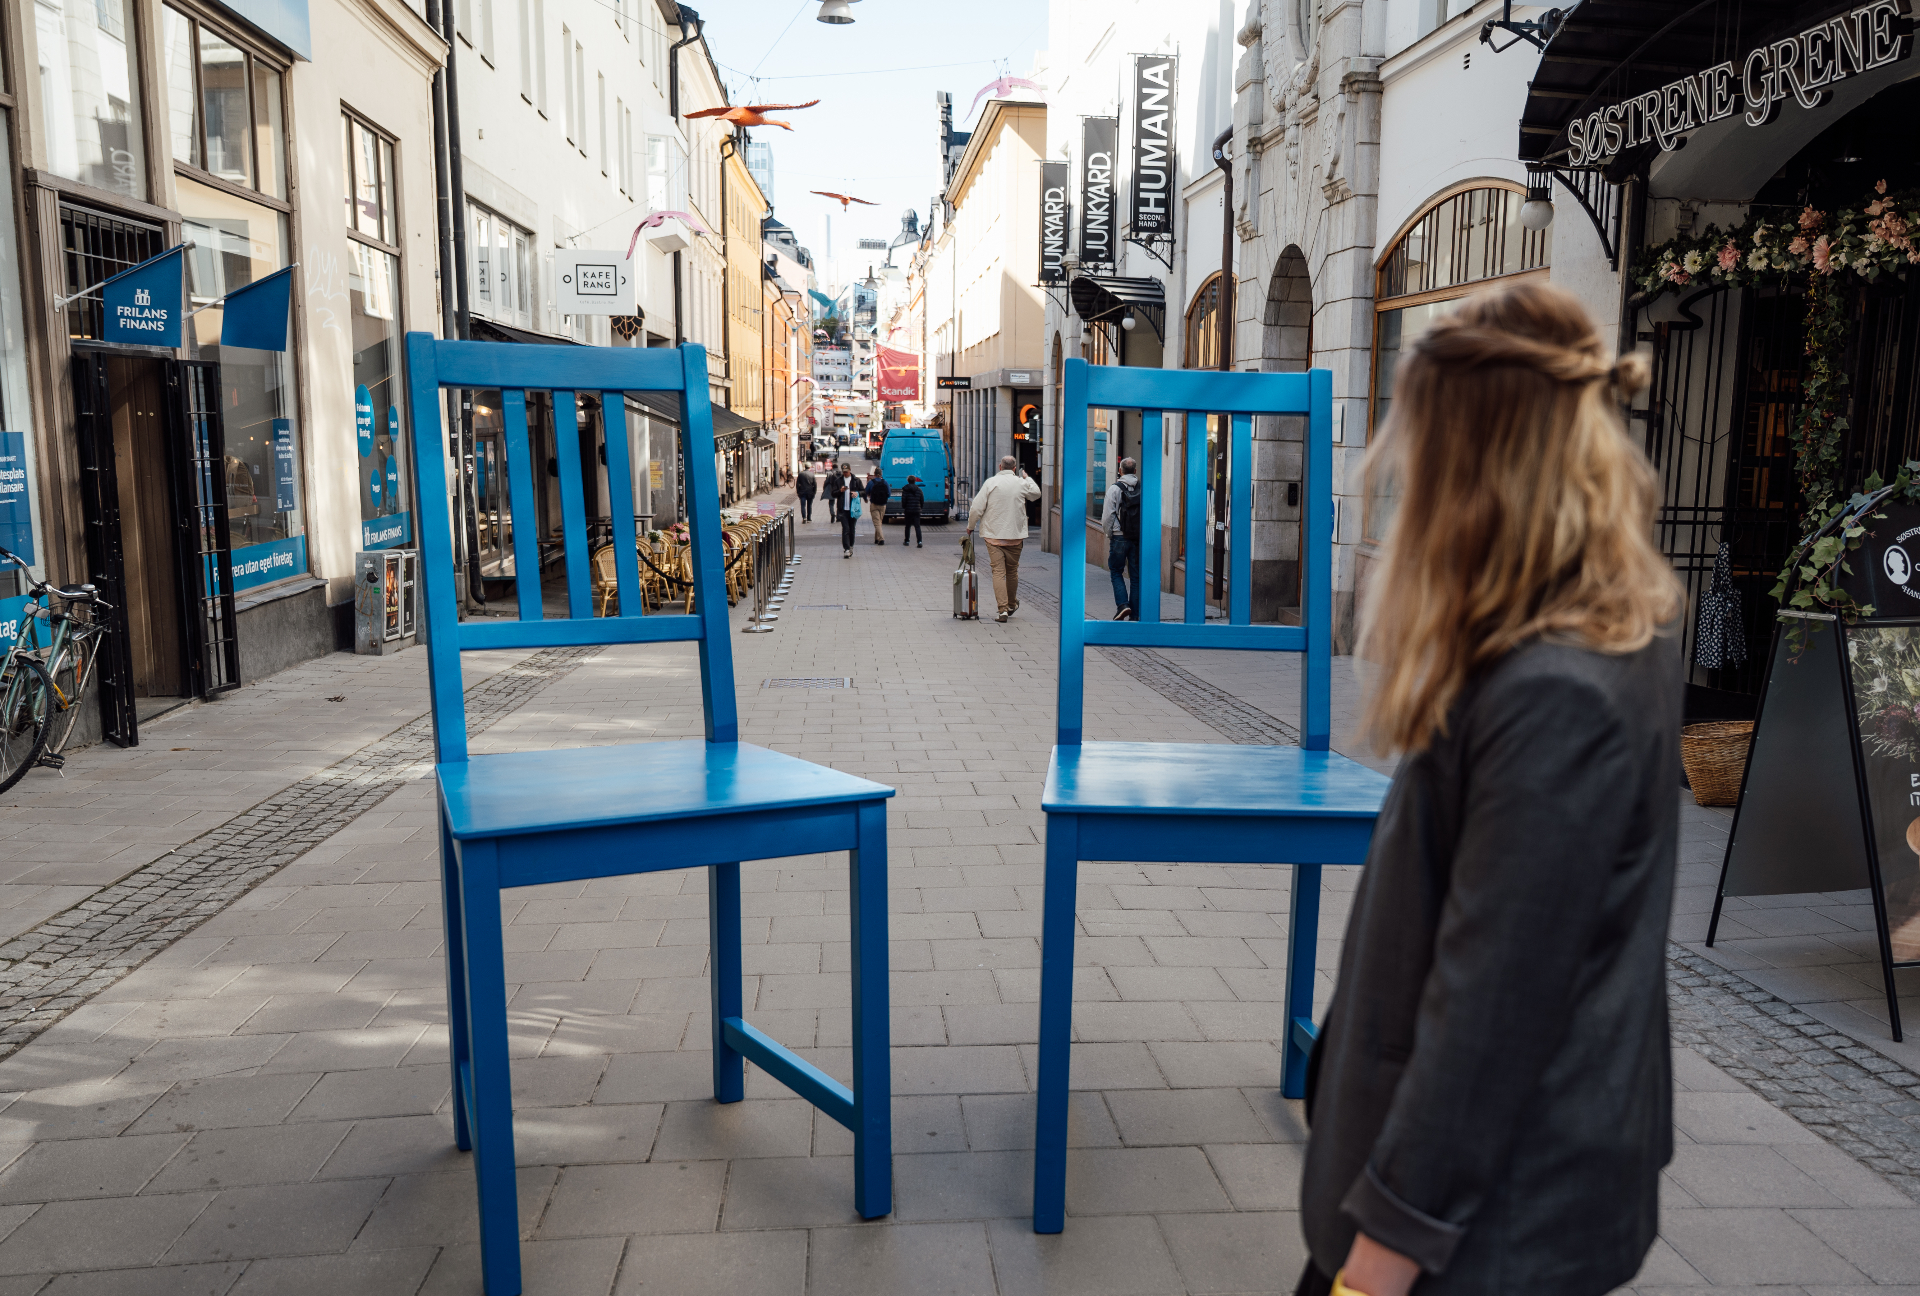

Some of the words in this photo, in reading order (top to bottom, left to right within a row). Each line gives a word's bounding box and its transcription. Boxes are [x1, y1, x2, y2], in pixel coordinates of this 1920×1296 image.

[1568, 61, 1735, 167] SØSTRENE
[1743, 0, 1901, 126] GRENE
[1138, 62, 1170, 214] HUMANA
[1086, 151, 1112, 257] JUNKYARD.
[1138, 220, 1158, 228] HAND
[1043, 186, 1065, 277] JUNKYARD.
[583, 271, 611, 279] KAFE
[583, 281, 611, 289] RANG
[117, 306, 168, 320] FRILANS
[119, 318, 165, 332] FINANS
[881, 386, 916, 396] Scandic
[1014, 432, 1030, 440] HATS
[892, 455, 915, 466] post
[0, 467, 25, 482] tesplats
[370, 529, 388, 543] FRILANS
[387, 525, 402, 539] FINANS
[1895, 526, 1920, 544] SØSTR
[244, 559, 259, 574] utan
[259, 554, 273, 573] eget
[272, 551, 293, 567] företag
